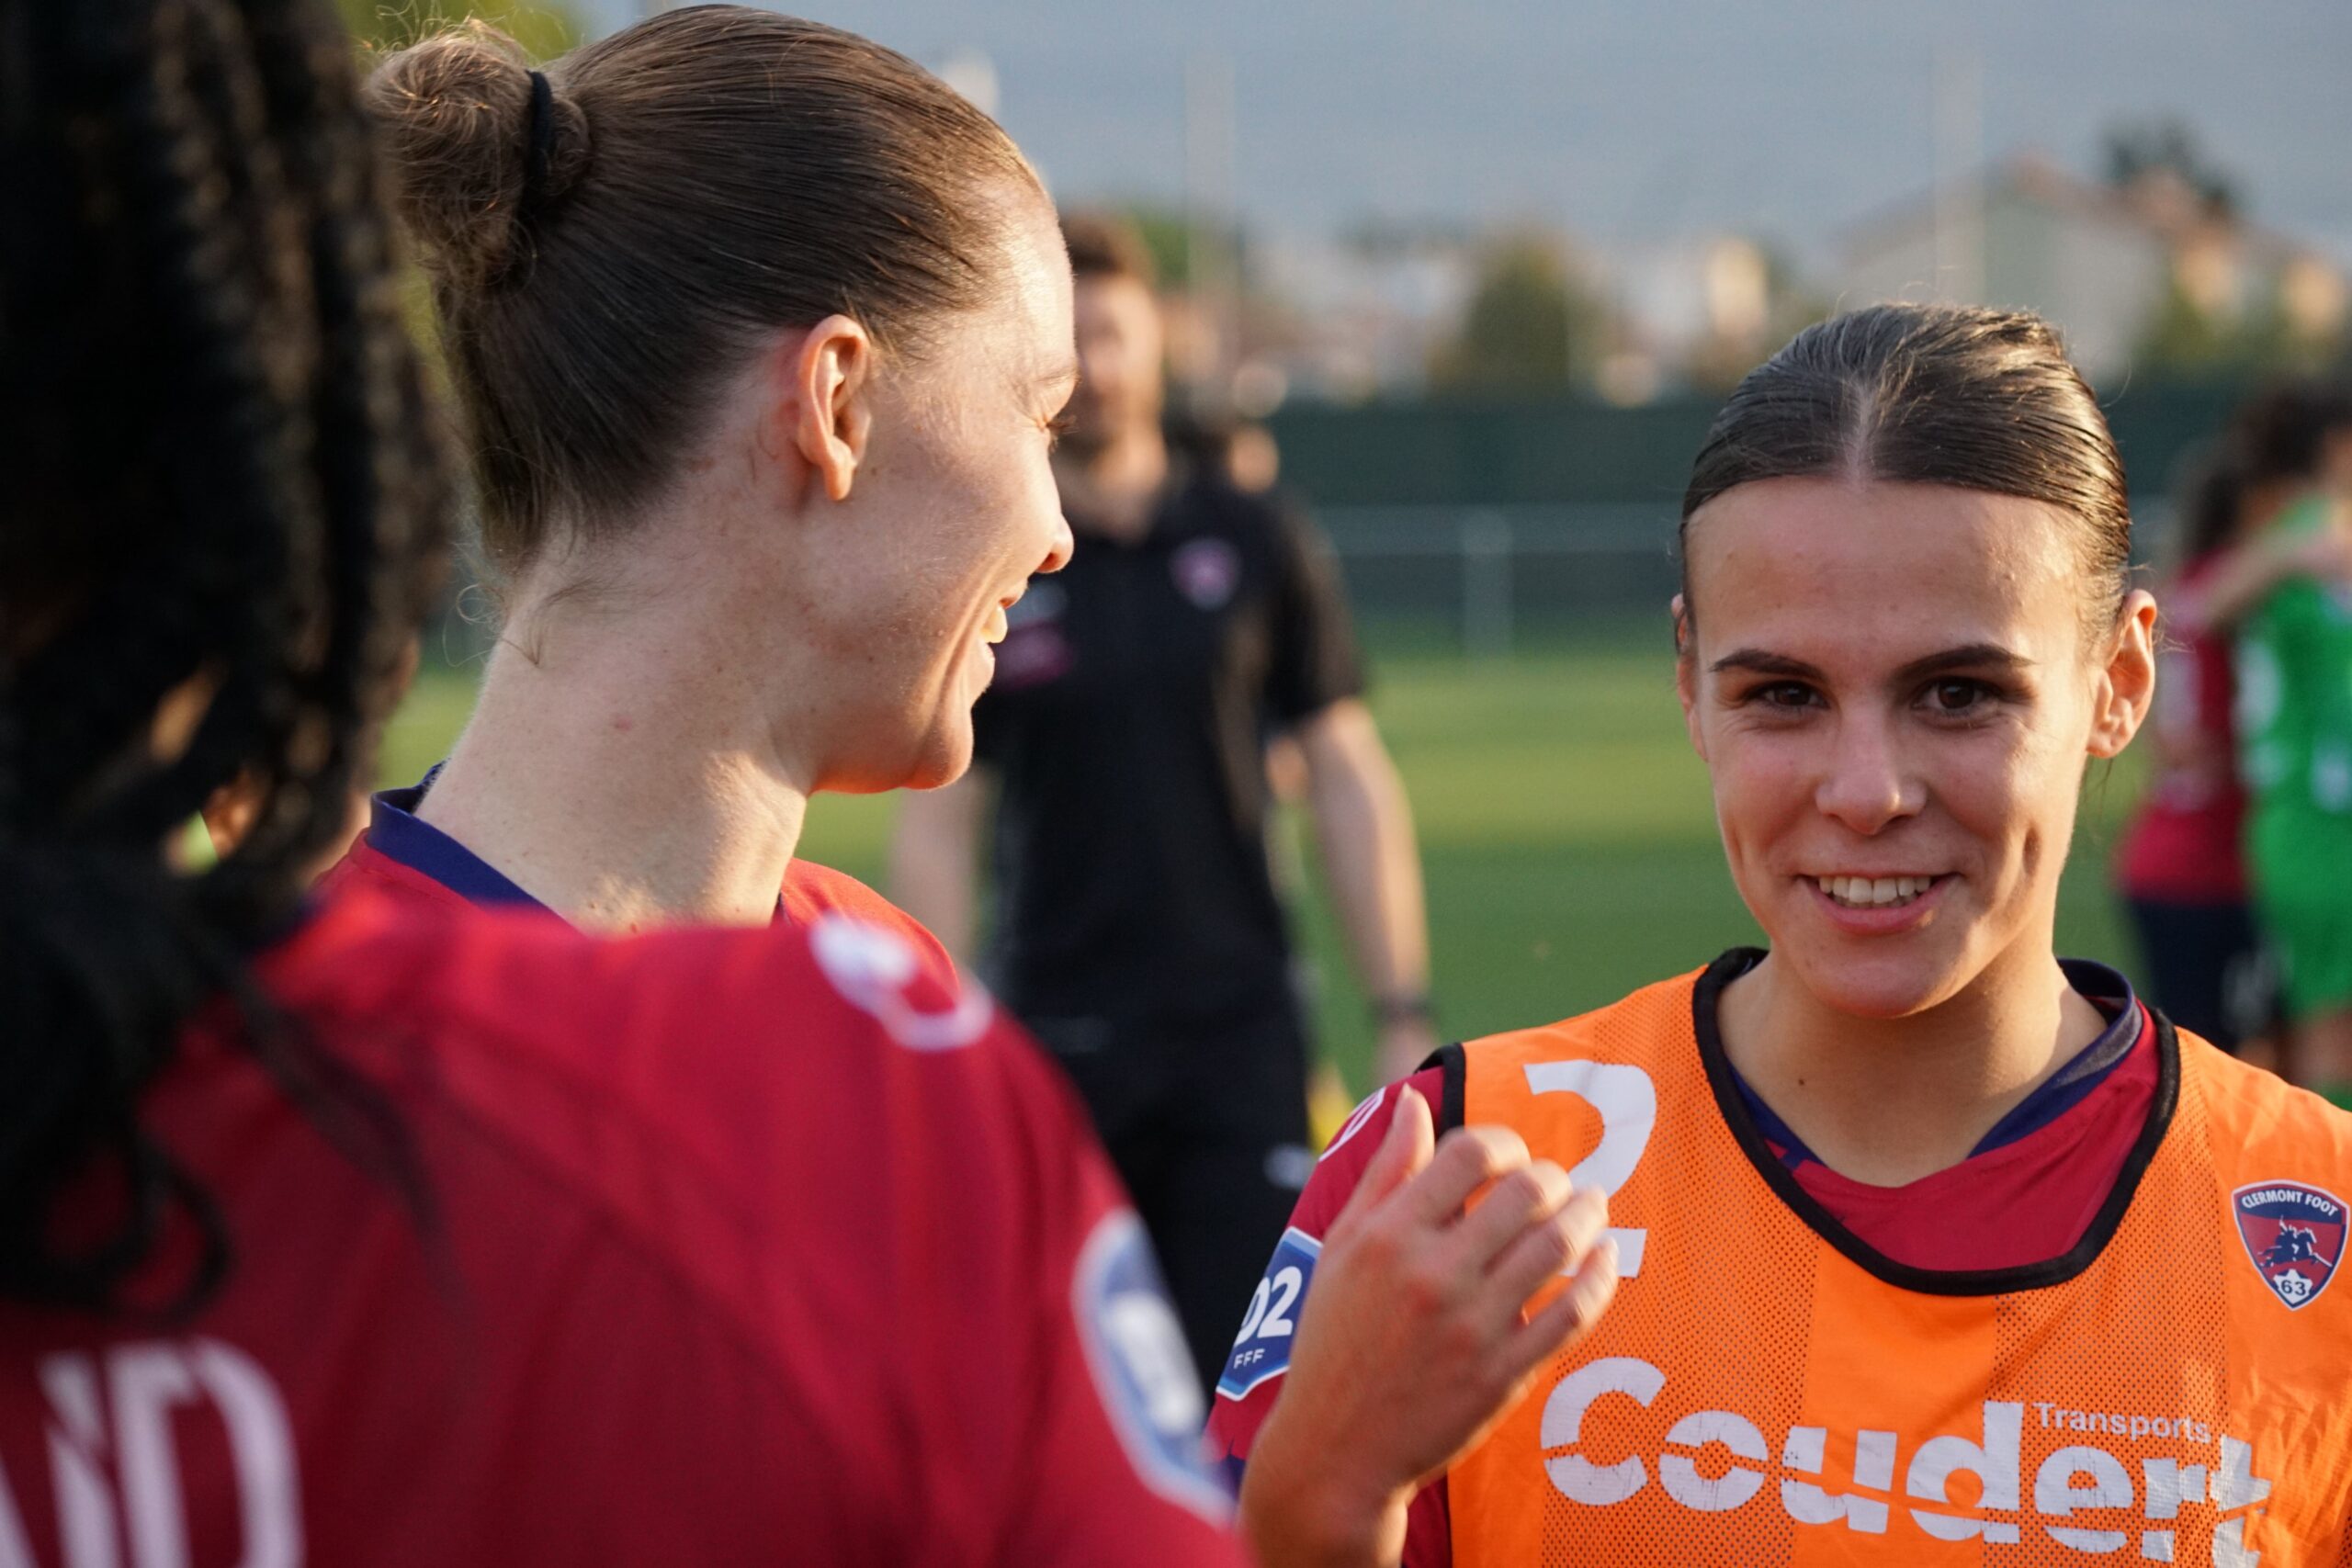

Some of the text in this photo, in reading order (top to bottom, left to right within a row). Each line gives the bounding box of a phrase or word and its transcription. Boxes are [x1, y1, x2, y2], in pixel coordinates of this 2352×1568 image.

[1522, 1059, 1657, 1279] 2
[2241, 1189, 2339, 1217] CLERMONT FOOT
[2280, 1279, 2307, 1297] 63
[1233, 1348, 1265, 1370] FFF
[2032, 1401, 2212, 1444] Transports
[1539, 1356, 2273, 1568] Coudert
